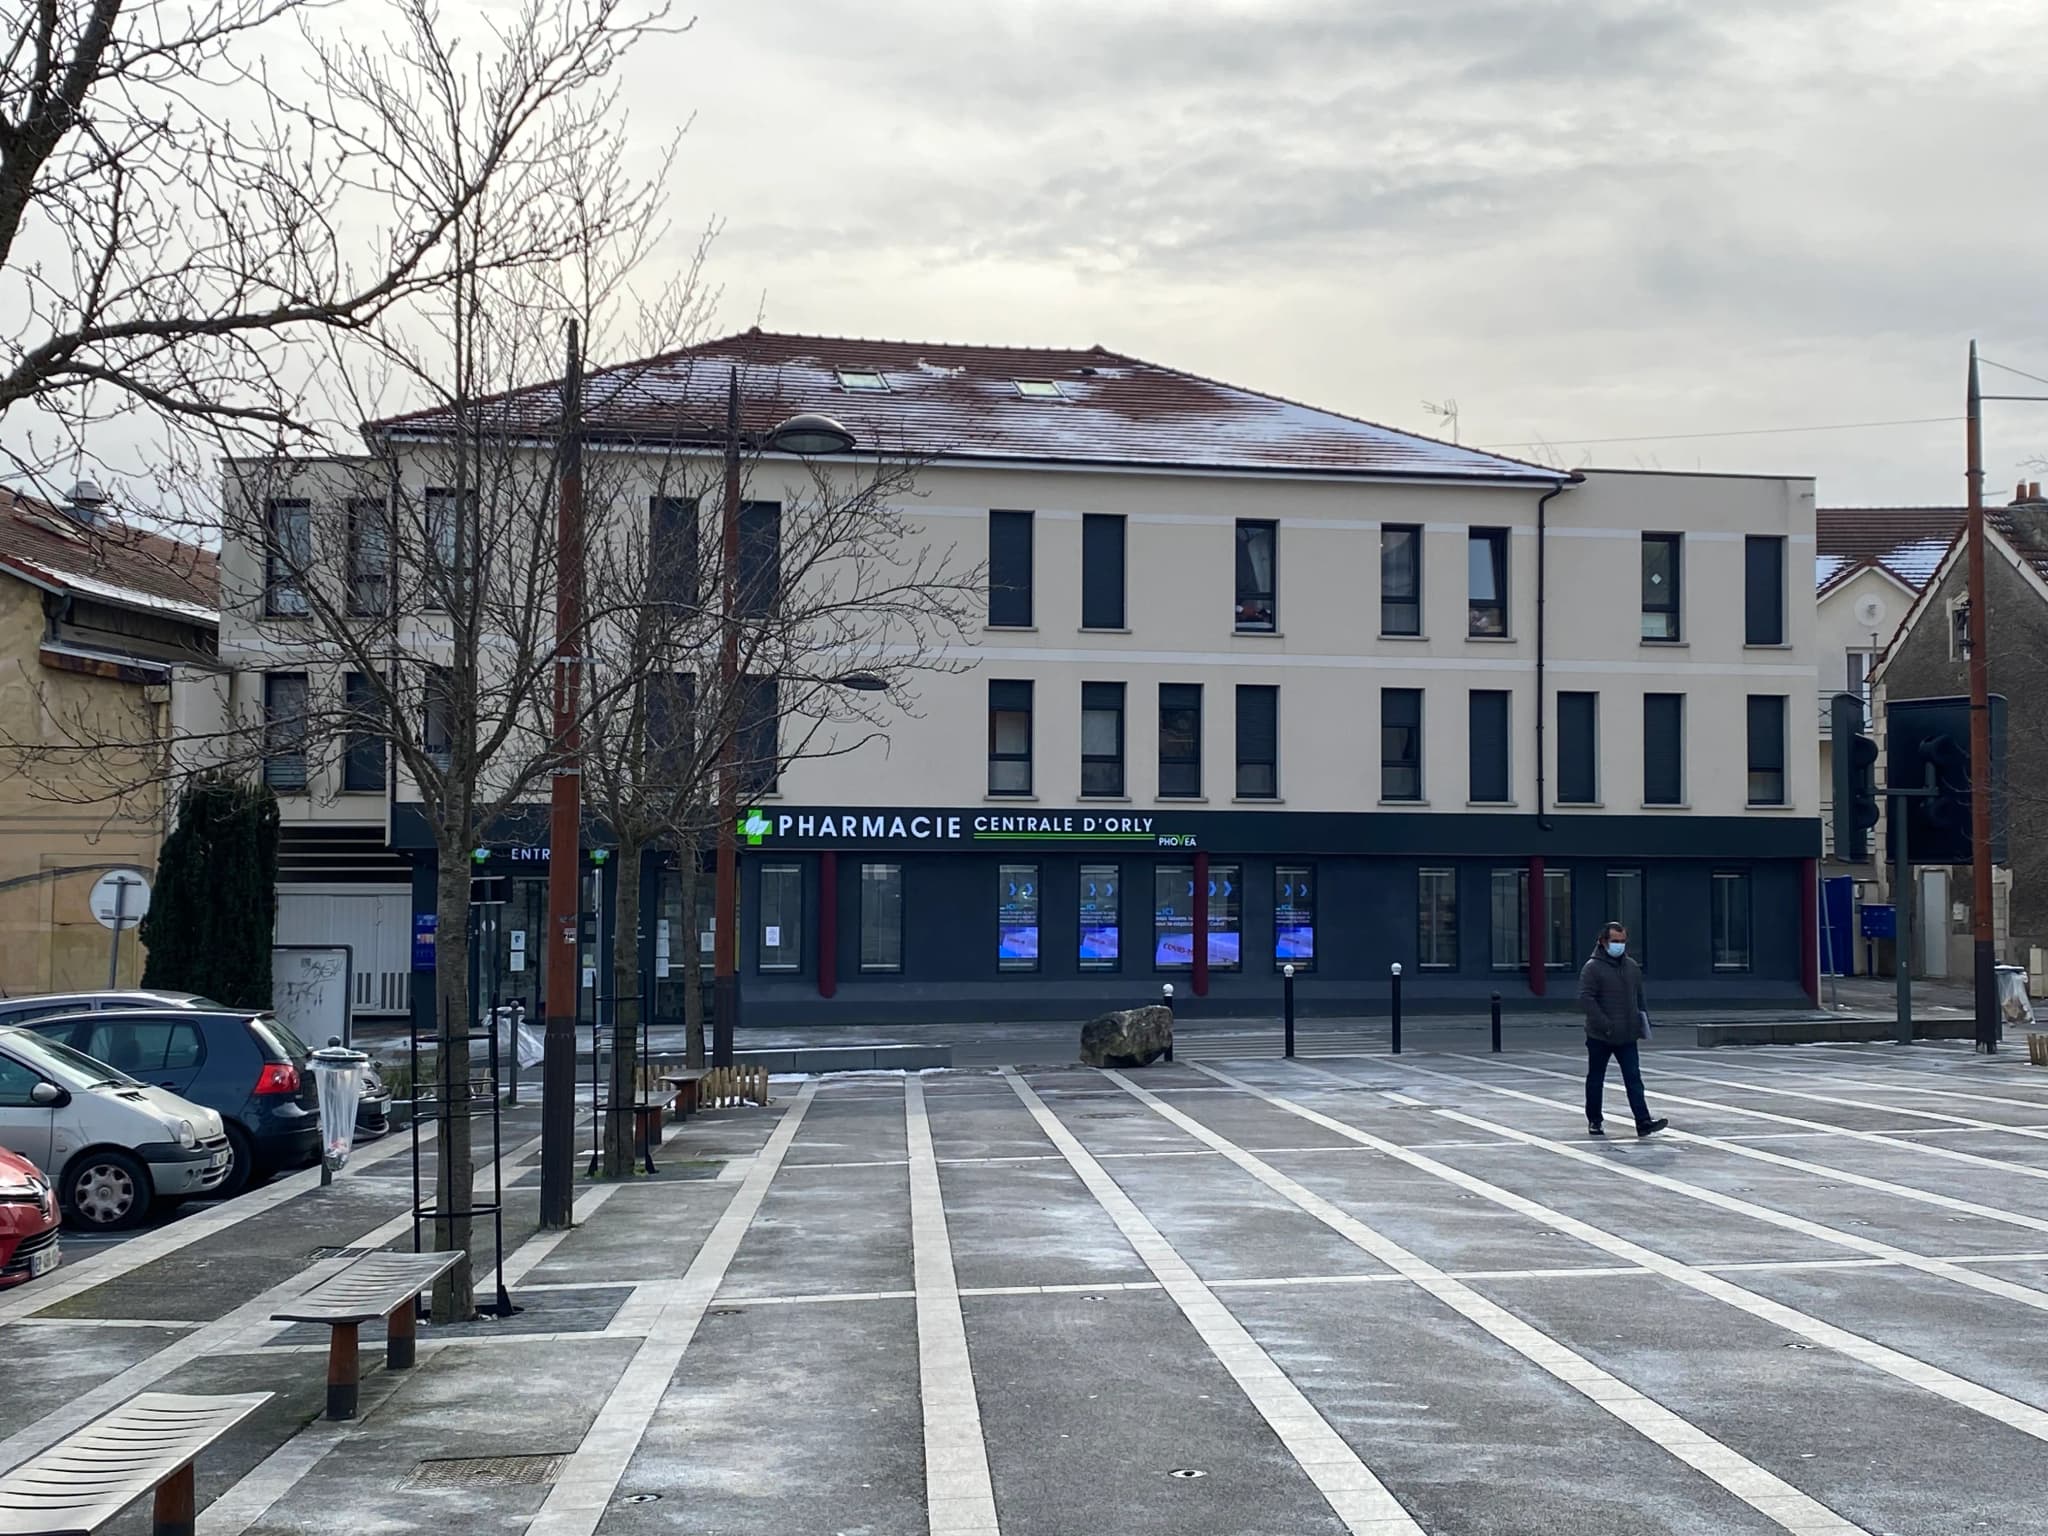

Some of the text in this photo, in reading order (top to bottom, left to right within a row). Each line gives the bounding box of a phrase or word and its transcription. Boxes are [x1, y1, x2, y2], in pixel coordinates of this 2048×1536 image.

[778, 815, 961, 838] PHARMACIE
[974, 816, 1153, 832] CENTRALE D'ORLY
[1158, 834, 1197, 847] PHOVEA
[511, 848, 551, 860] ENTR
